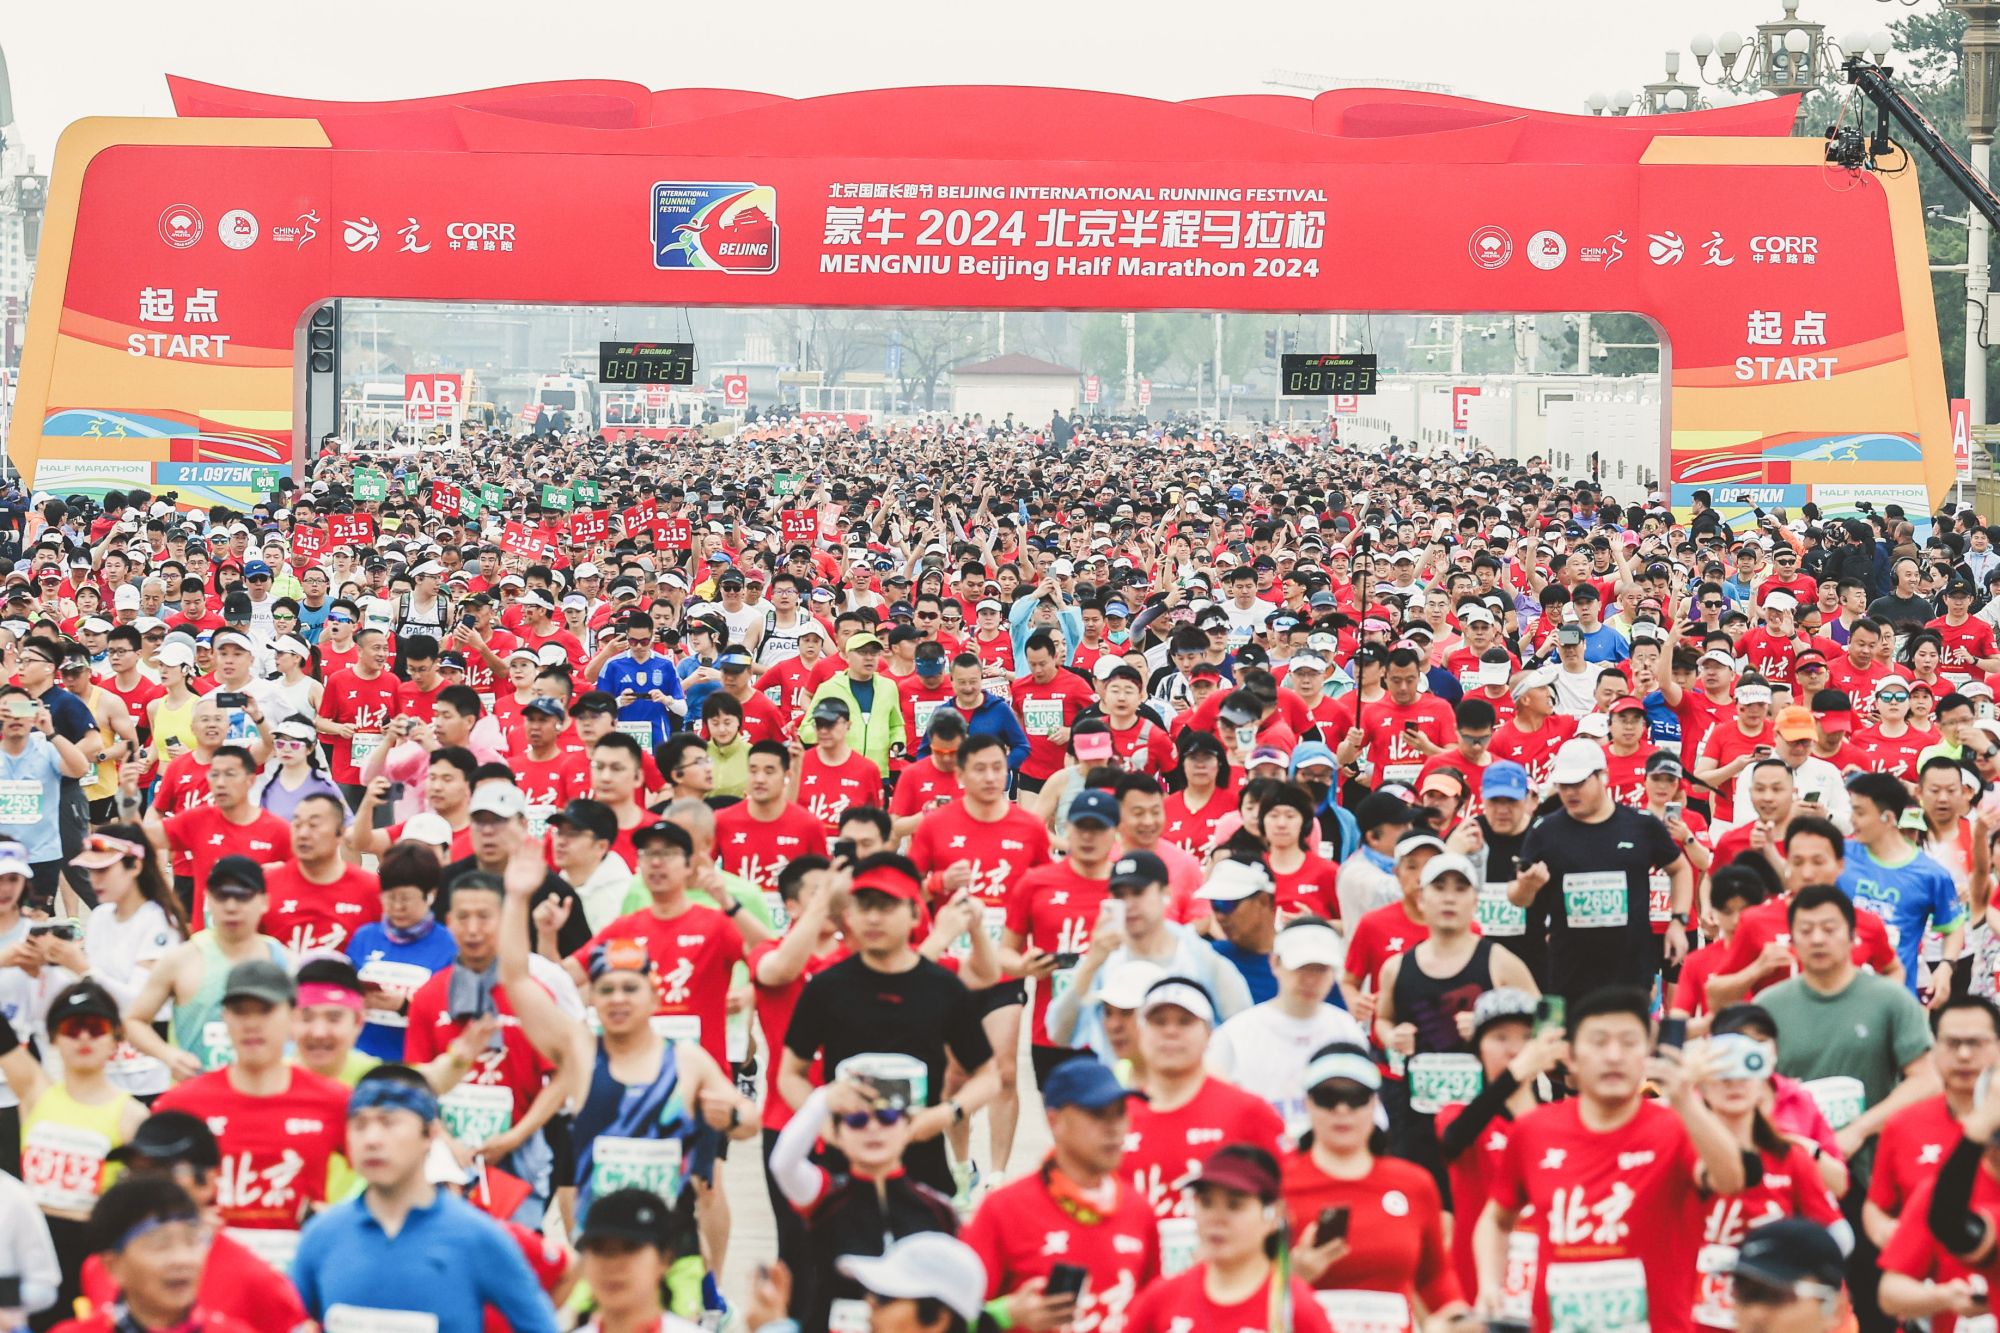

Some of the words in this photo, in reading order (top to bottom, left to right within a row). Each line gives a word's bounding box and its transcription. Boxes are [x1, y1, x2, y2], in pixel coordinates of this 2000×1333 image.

[659, 190, 709, 198] INTERNATIONAL
[659, 197, 697, 206] RUNNING
[828, 183, 934, 200] 北京国际长跑节
[937, 186, 1005, 200] BEIJING
[1009, 186, 1155, 201] INTERNATIONAL
[1158, 187, 1242, 202] RUNNING
[1245, 189, 1328, 203] FESTIVAL
[659, 205, 691, 214] FESTIVAL
[273, 227, 301, 236] CHINA
[446, 222, 516, 241] CORR
[823, 205, 907, 246] 蒙牛
[915, 208, 1026, 248] 2024
[1035, 208, 1326, 249] 北京半程马拉松
[449, 241, 513, 252] 中奥路跑
[718, 243, 768, 257] BEIJING
[1580, 247, 1608, 256] CHINA
[1750, 235, 1819, 254] CORR
[819, 254, 951, 275] MENGNIU
[957, 255, 1049, 281] Beijing
[1056, 256, 1113, 276] Half
[1117, 257, 1246, 278] Marathon
[1252, 258, 1320, 278] 2024
[1752, 253, 1816, 265] 中奥路跑
[139, 287, 219, 323] 起点
[1747, 310, 1827, 346] 起点
[127, 334, 231, 359] START
[606, 361, 686, 380] 0:07:23
[1735, 357, 1839, 381] START
[727, 379, 744, 399] C
[1290, 372, 1370, 391] 0:07:23
[1952, 411, 1968, 455] A
[40, 464, 71, 473] HALF
[74, 464, 145, 474] MARATHON
[178, 466, 269, 483] 21.0975K
[256, 476, 275, 488] 收尾
[359, 484, 380, 495] 收尾
[435, 490, 457, 510] 2:15
[484, 489, 500, 502] 收尾
[546, 491, 567, 507] 收尾
[577, 486, 595, 499] 收尾
[1819, 488, 1850, 498] HALF
[1854, 488, 1924, 498] MARATHON
[333, 522, 368, 537] 2:15
[575, 519, 604, 536] 2:15
[627, 511, 655, 530] 2:15
[786, 518, 815, 533] 2:15
[297, 533, 320, 551] 2:15
[506, 530, 541, 552] 2:15
[657, 527, 687, 542] 2:15
[464, 664, 495, 687] 北京
[1759, 655, 1789, 679] 北京
[1026, 709, 1061, 723] C1066
[1568, 890, 1623, 913] C2690
[216, 1148, 304, 1208] 北京
[1547, 1181, 1636, 1245] 北京
